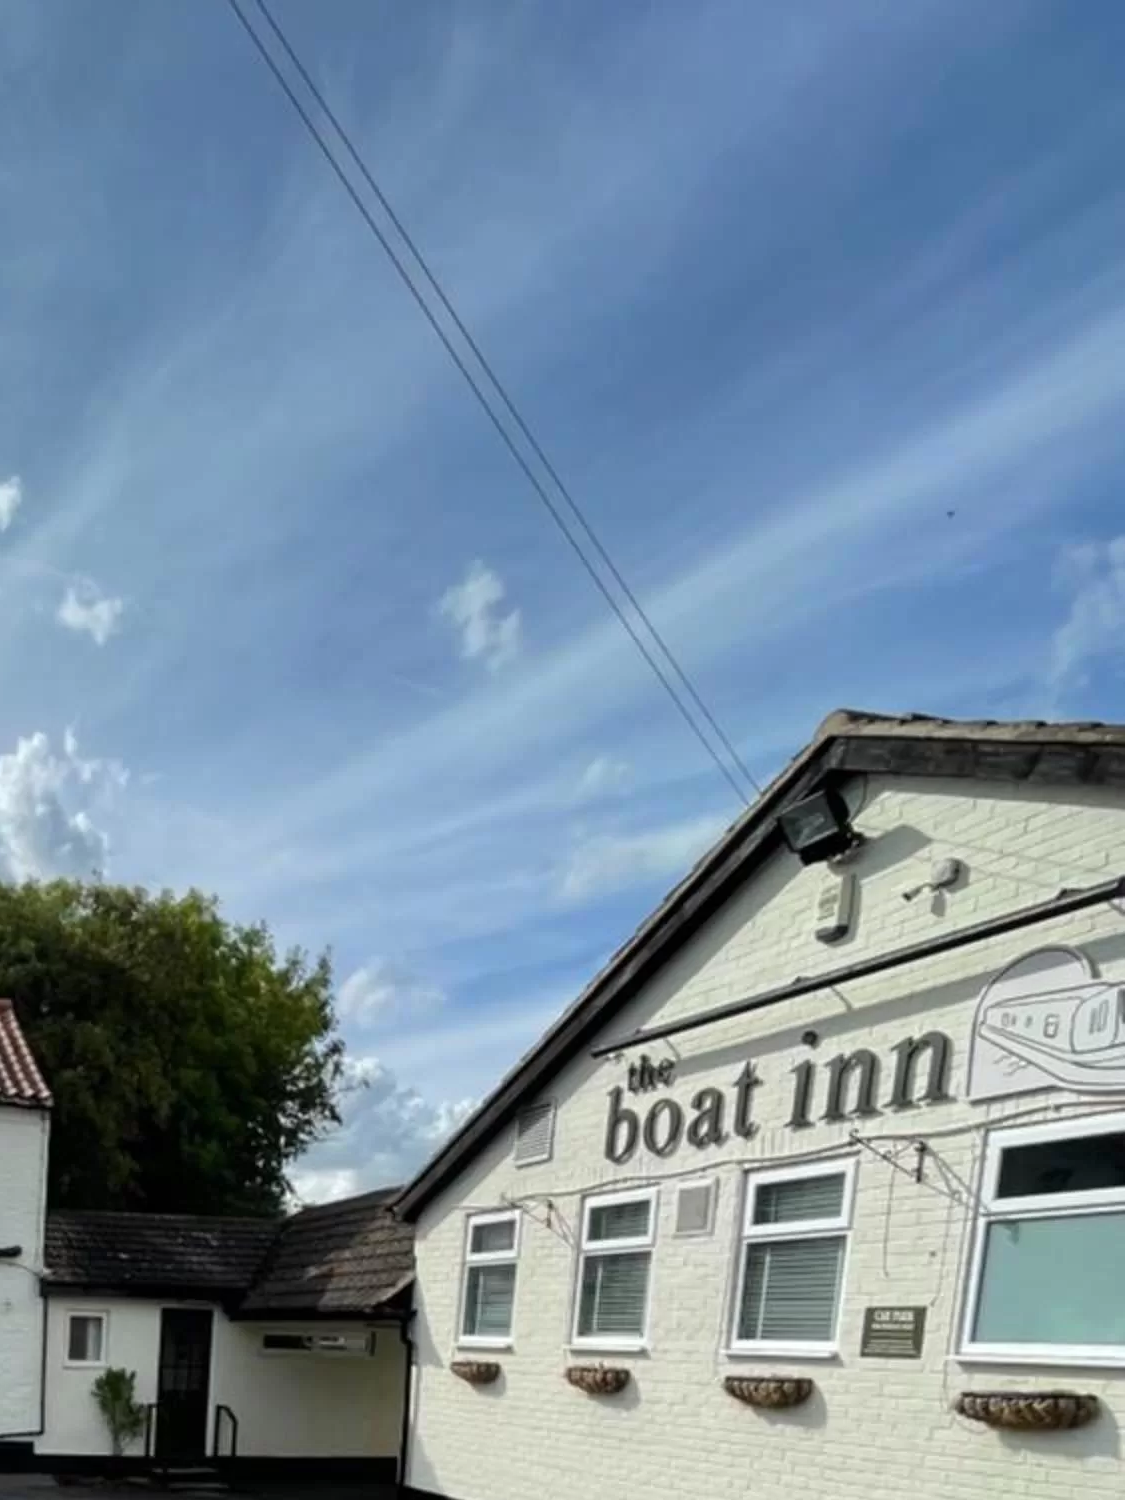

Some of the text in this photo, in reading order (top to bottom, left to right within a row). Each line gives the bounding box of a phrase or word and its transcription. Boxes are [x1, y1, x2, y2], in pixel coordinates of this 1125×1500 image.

[605, 1030, 956, 1165] boat inn
[628, 1054, 675, 1094] the
